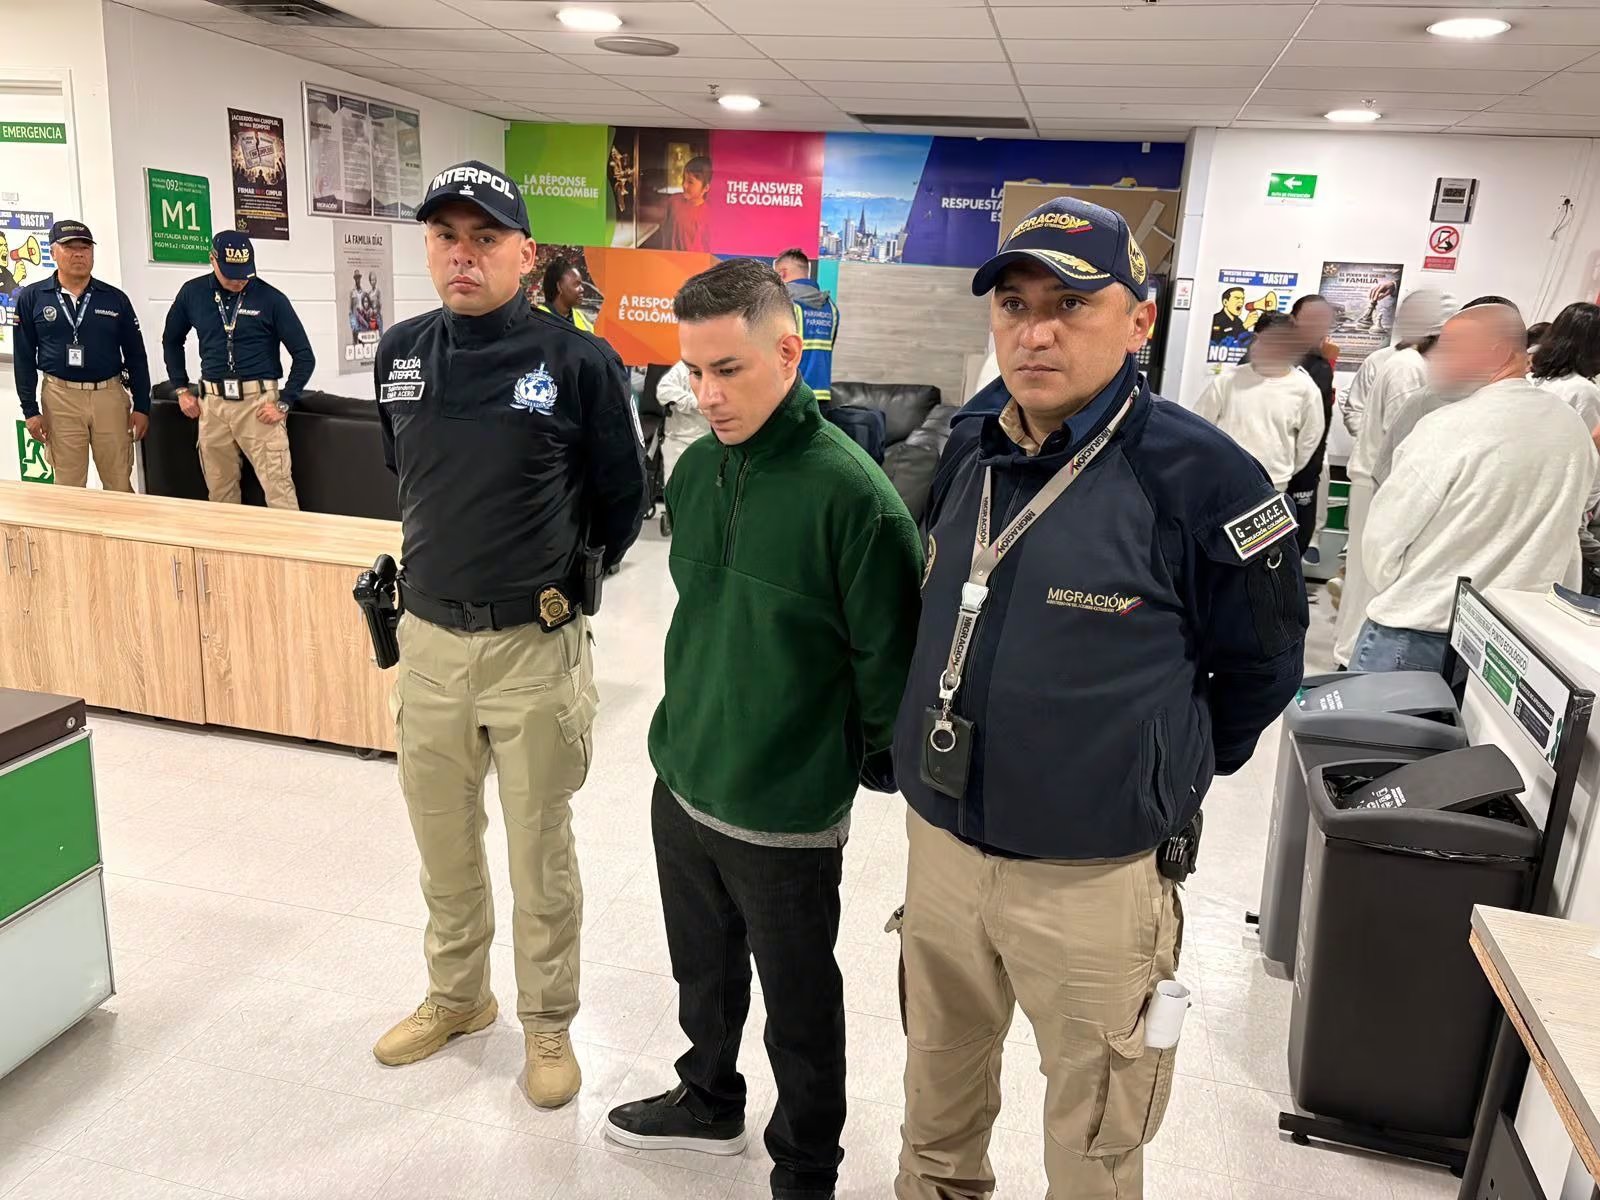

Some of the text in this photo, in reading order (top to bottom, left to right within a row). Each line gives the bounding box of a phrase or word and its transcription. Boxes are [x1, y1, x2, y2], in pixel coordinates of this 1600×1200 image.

[3, 126, 62, 139] EMERGENCIA
[166, 179, 179, 191] 092
[432, 166, 514, 200] INTERPOL
[524, 173, 587, 187] LA RÉPONSE
[518, 185, 599, 198] ST LA COLOMBIE
[727, 181, 803, 195] THE ANSWER
[991, 188, 1004, 199] LA
[726, 193, 803, 207] IS COLOMBIA
[942, 198, 1003, 210] RESPUESTA
[162, 199, 200, 231] M1
[225, 248, 249, 258] UAE
[620, 296, 674, 309] A RESPOS
[619, 306, 626, 320] É
[1209, 345, 1228, 361] NO
[393, 356, 421, 369] POLICÍA
[1072, 427, 1111, 471] MIGRACIÓN
[997, 510, 1036, 554] MIGRACIÓN
[1235, 527, 1245, 538] G
[1047, 587, 1128, 610] MIGRACIÓN
[1492, 628, 1527, 671] PUNTO ECOLÓGICO
